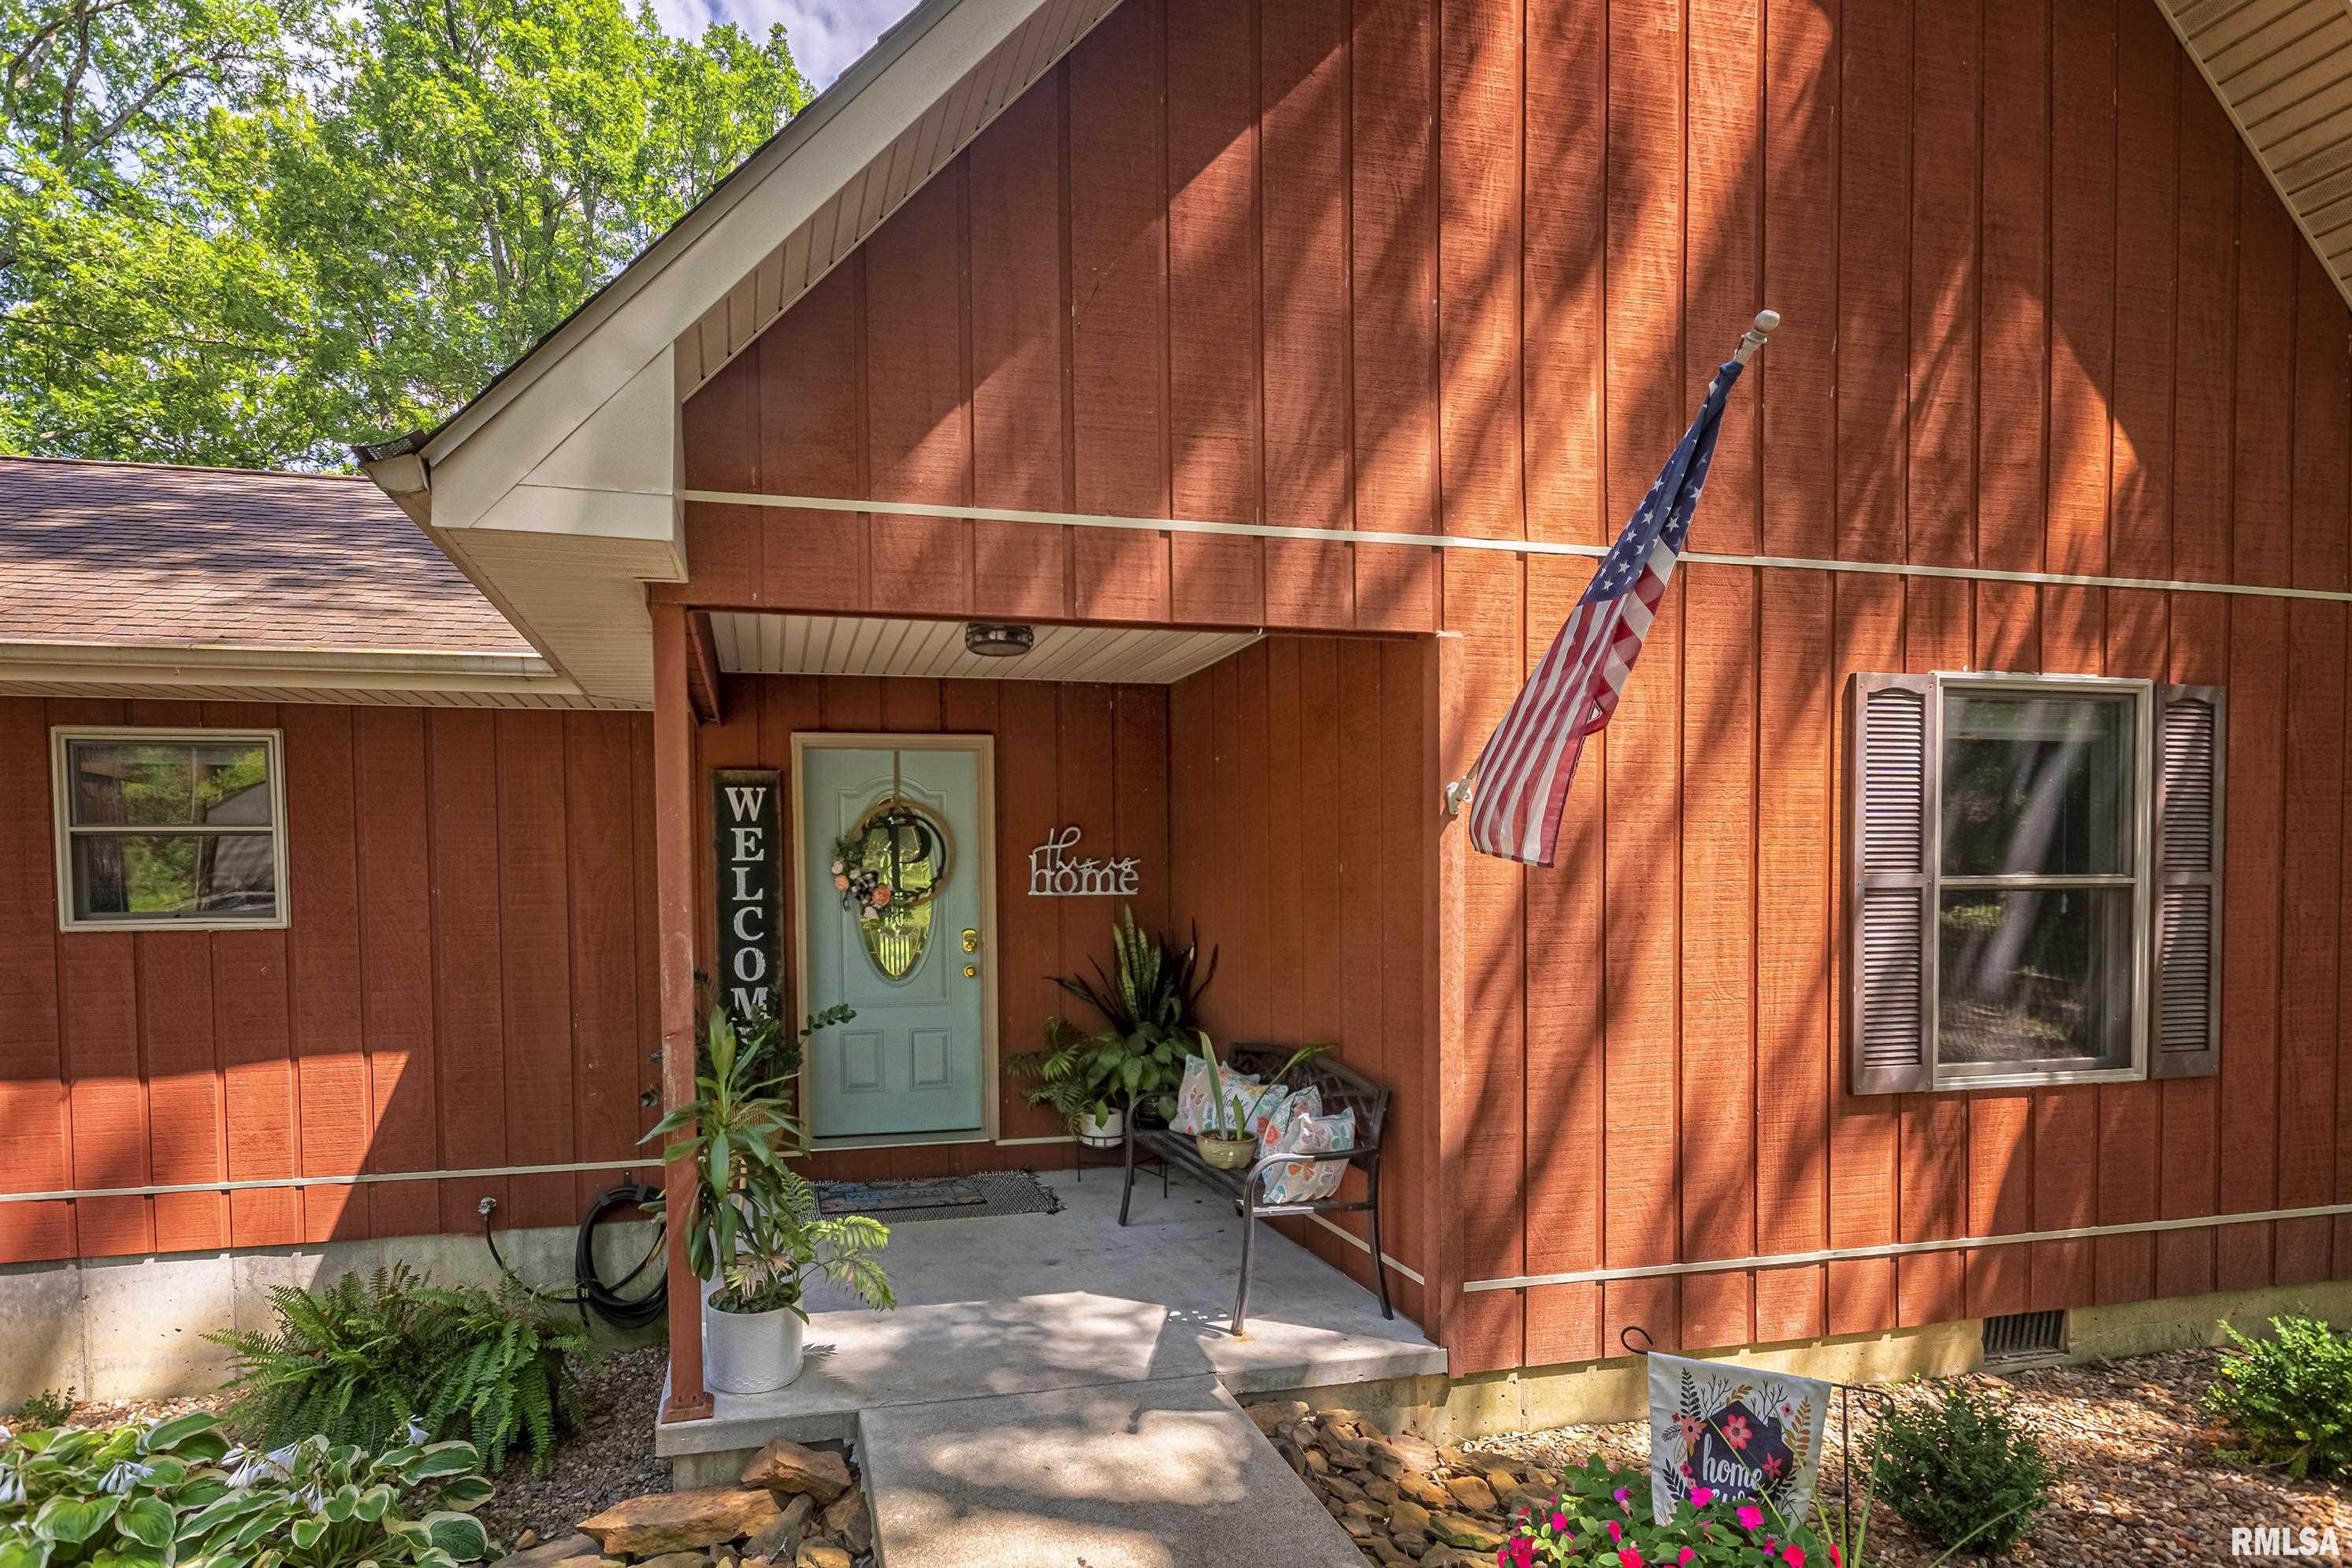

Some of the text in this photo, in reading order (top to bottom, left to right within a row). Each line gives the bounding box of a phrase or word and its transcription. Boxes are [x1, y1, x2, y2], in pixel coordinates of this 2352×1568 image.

[1028, 853, 1139, 896] home
[725, 787, 771, 1045] WELCOM
[847, 1186, 951, 1200] WELCOME
[1702, 1432, 1763, 1492] home
